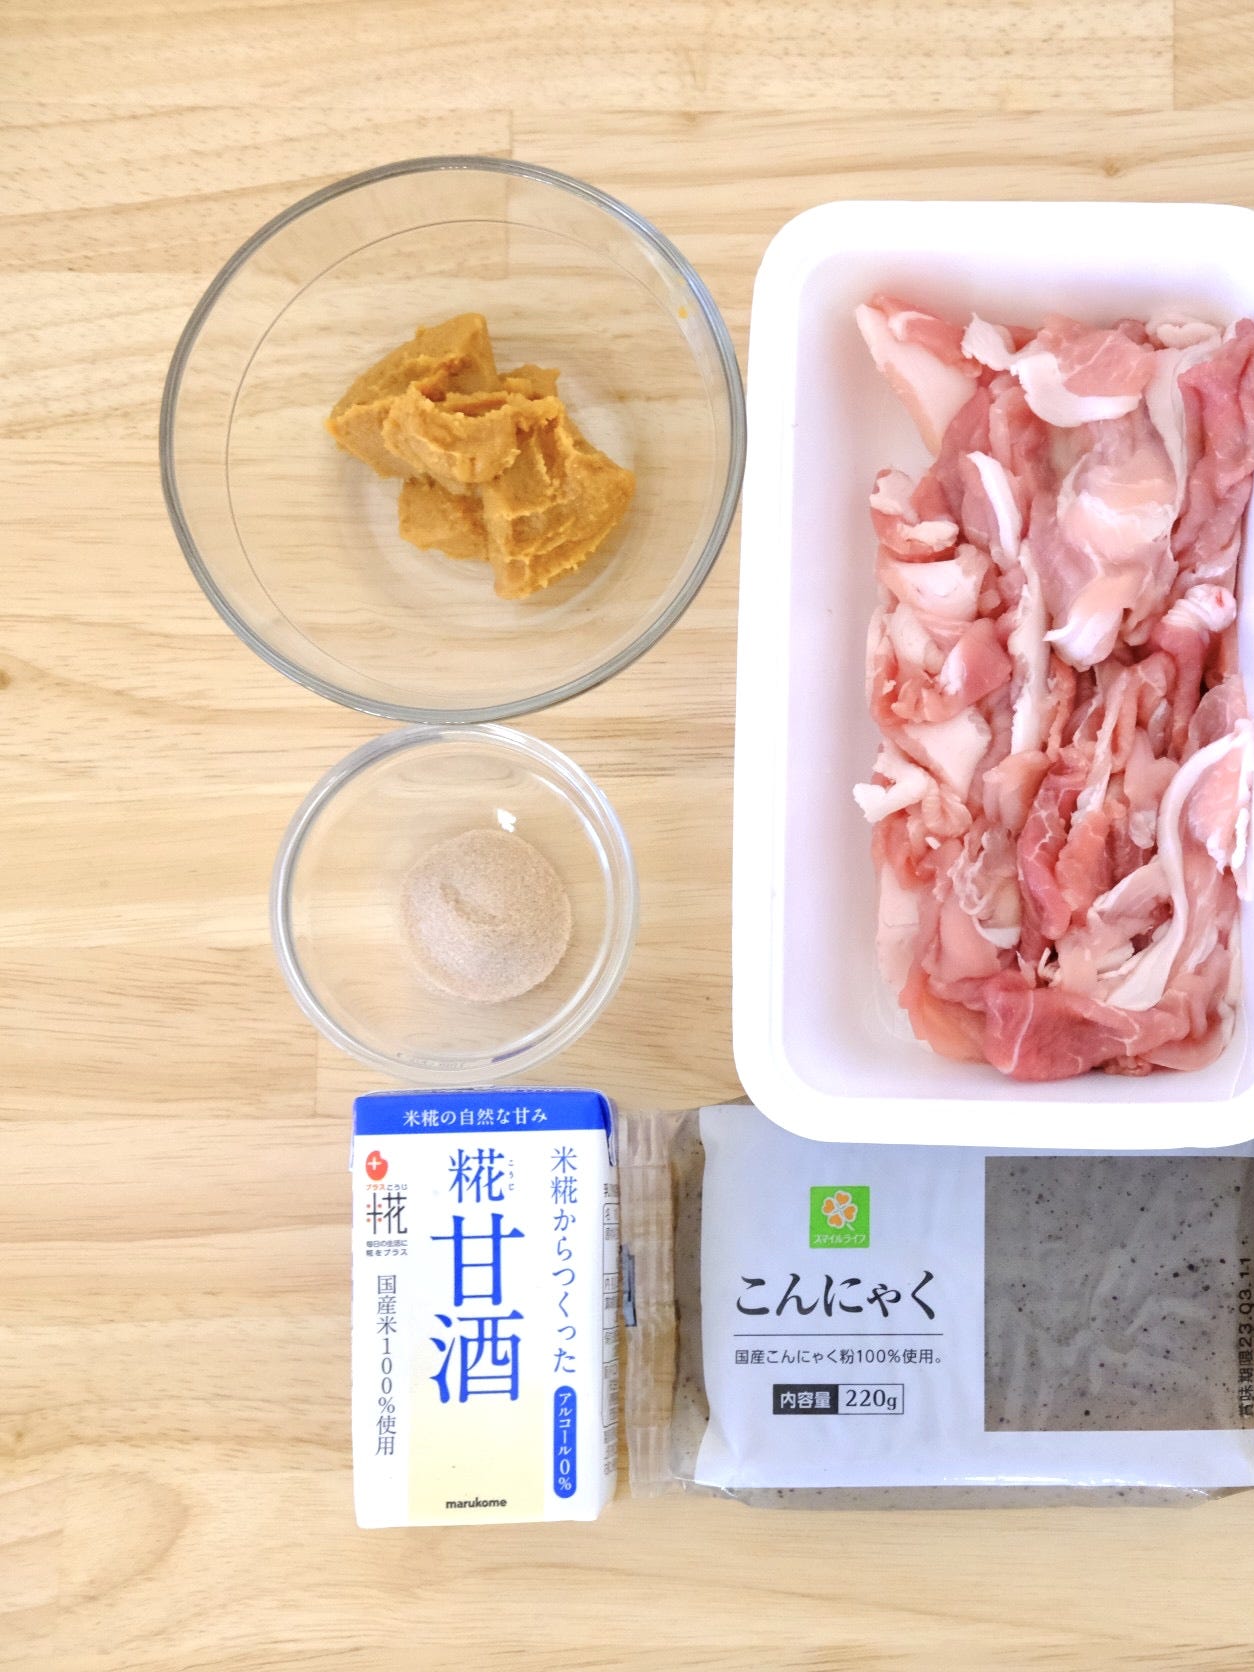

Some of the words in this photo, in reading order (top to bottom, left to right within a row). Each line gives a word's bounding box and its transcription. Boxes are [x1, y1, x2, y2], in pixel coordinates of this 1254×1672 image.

[403, 1108, 547, 1127] 米糀の自然な甘み
[815, 1234, 866, 1244] スマイルライフ
[550, 1146, 578, 1373] 米糀からつくった
[736, 1270, 936, 1320] こんにゃく
[376, 1275, 397, 1456] 国産米100%使用
[735, 1349, 942, 1364] 国産こんにゃく粉100%使用。
[780, 1391, 831, 1409] 内容量
[845, 1389, 898, 1411] 220g
[557, 1393, 572, 1491] アルコール0%
[445, 1498, 507, 1509] marukome
